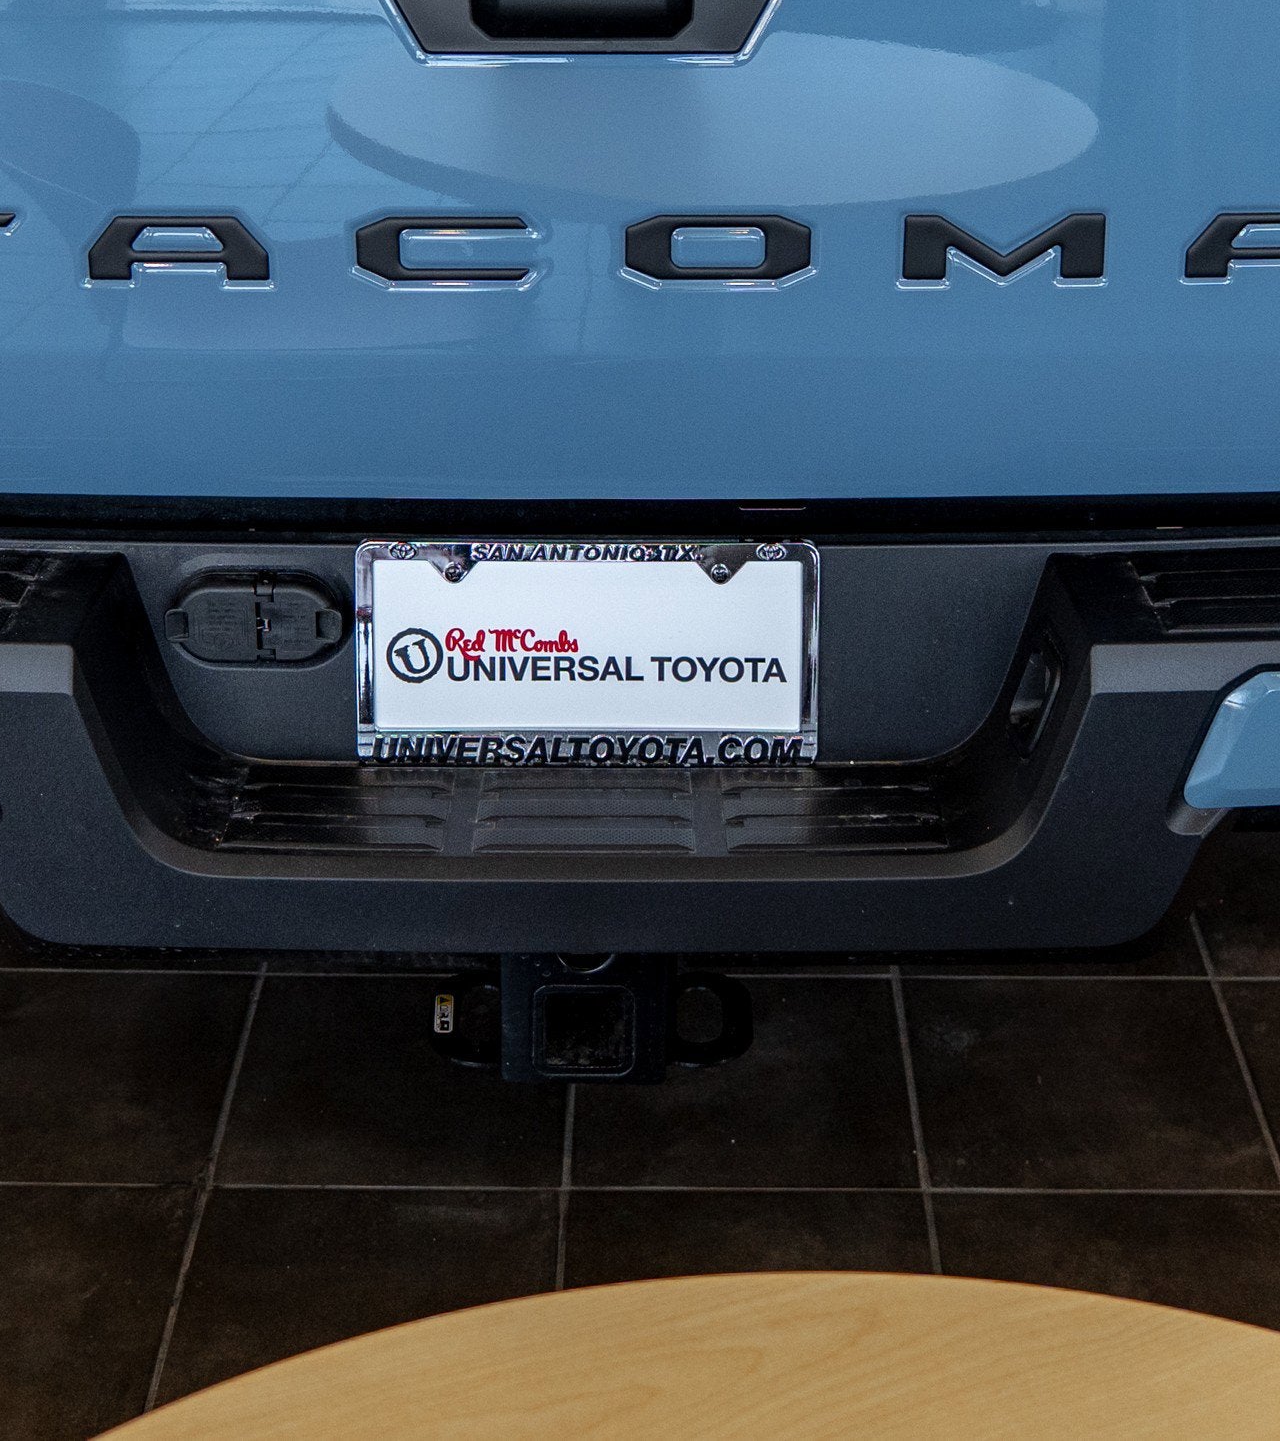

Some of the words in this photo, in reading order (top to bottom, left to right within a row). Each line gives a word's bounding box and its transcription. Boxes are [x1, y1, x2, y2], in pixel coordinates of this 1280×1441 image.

[470, 543, 527, 561] SAN
[445, 628, 485, 660] Red
[488, 628, 579, 653] McCombs
[447, 655, 644, 682] UNIVERSAL
[650, 656, 788, 683] TOYOTA
[372, 734, 804, 764] UNIVERSALTOYOTA.COM
